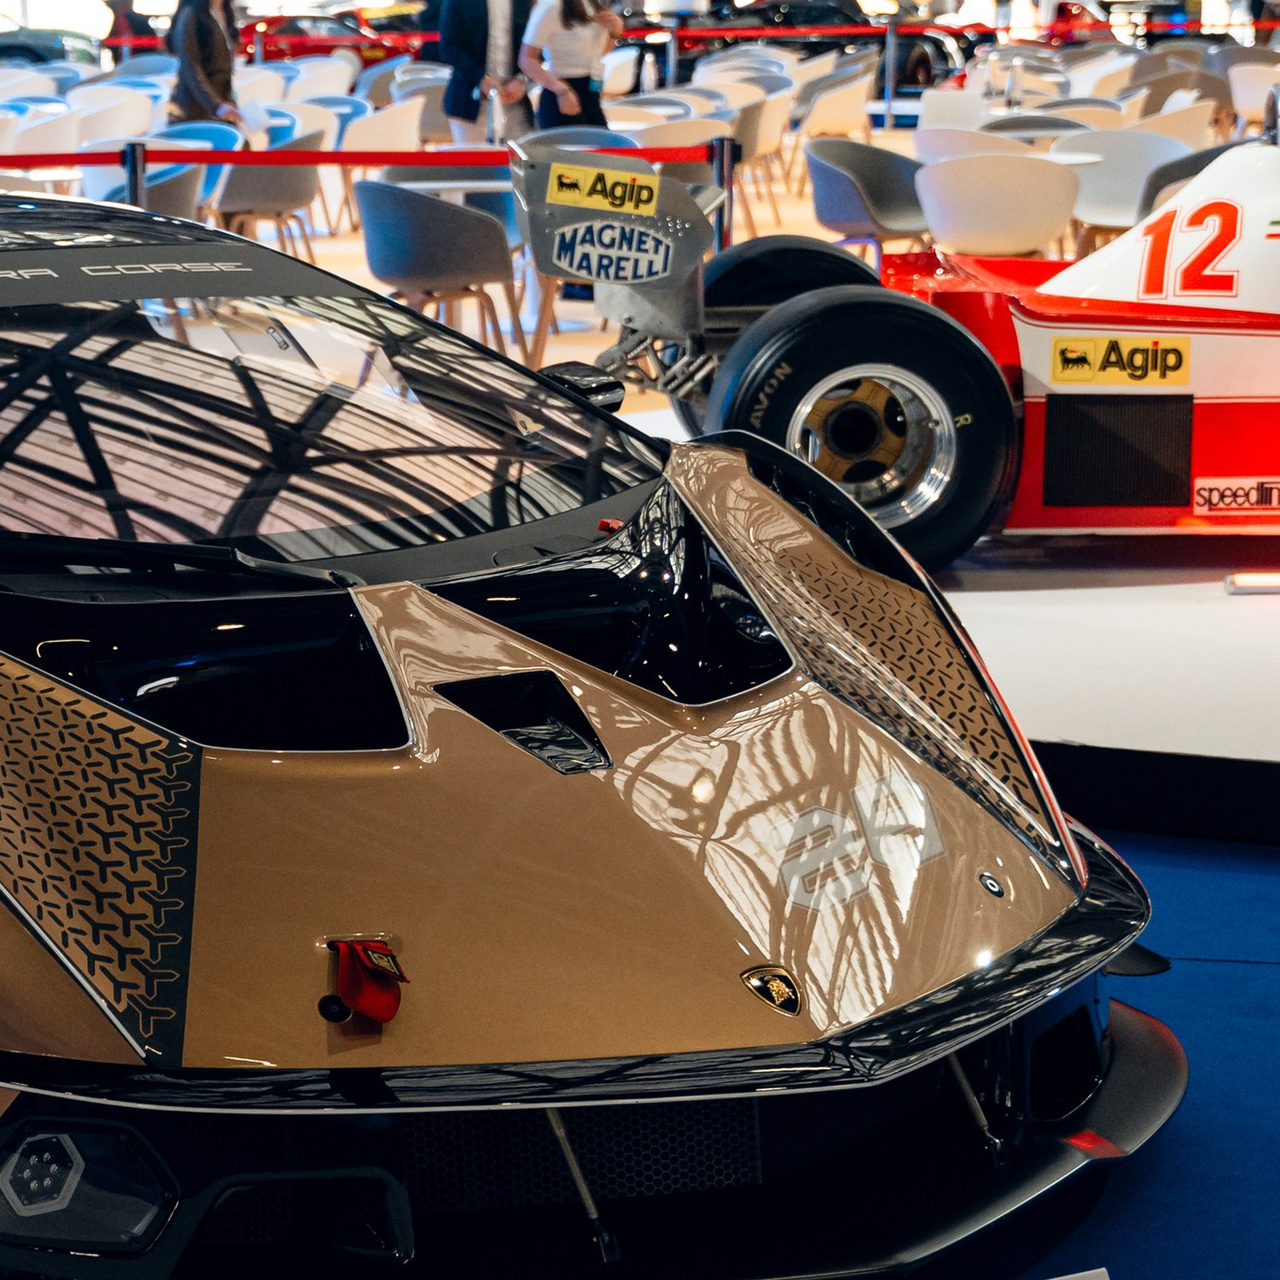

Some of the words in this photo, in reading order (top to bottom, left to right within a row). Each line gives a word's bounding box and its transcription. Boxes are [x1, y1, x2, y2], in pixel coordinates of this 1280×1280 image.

[586, 172, 654, 210] Agip
[556, 223, 671, 264] MAGNETI
[556, 240, 671, 281] MARELLI
[1137, 197, 1245, 301] 12
[80, 262, 253, 277] CORSE
[1098, 339, 1183, 381] Agip
[750, 362, 794, 430] AVON
